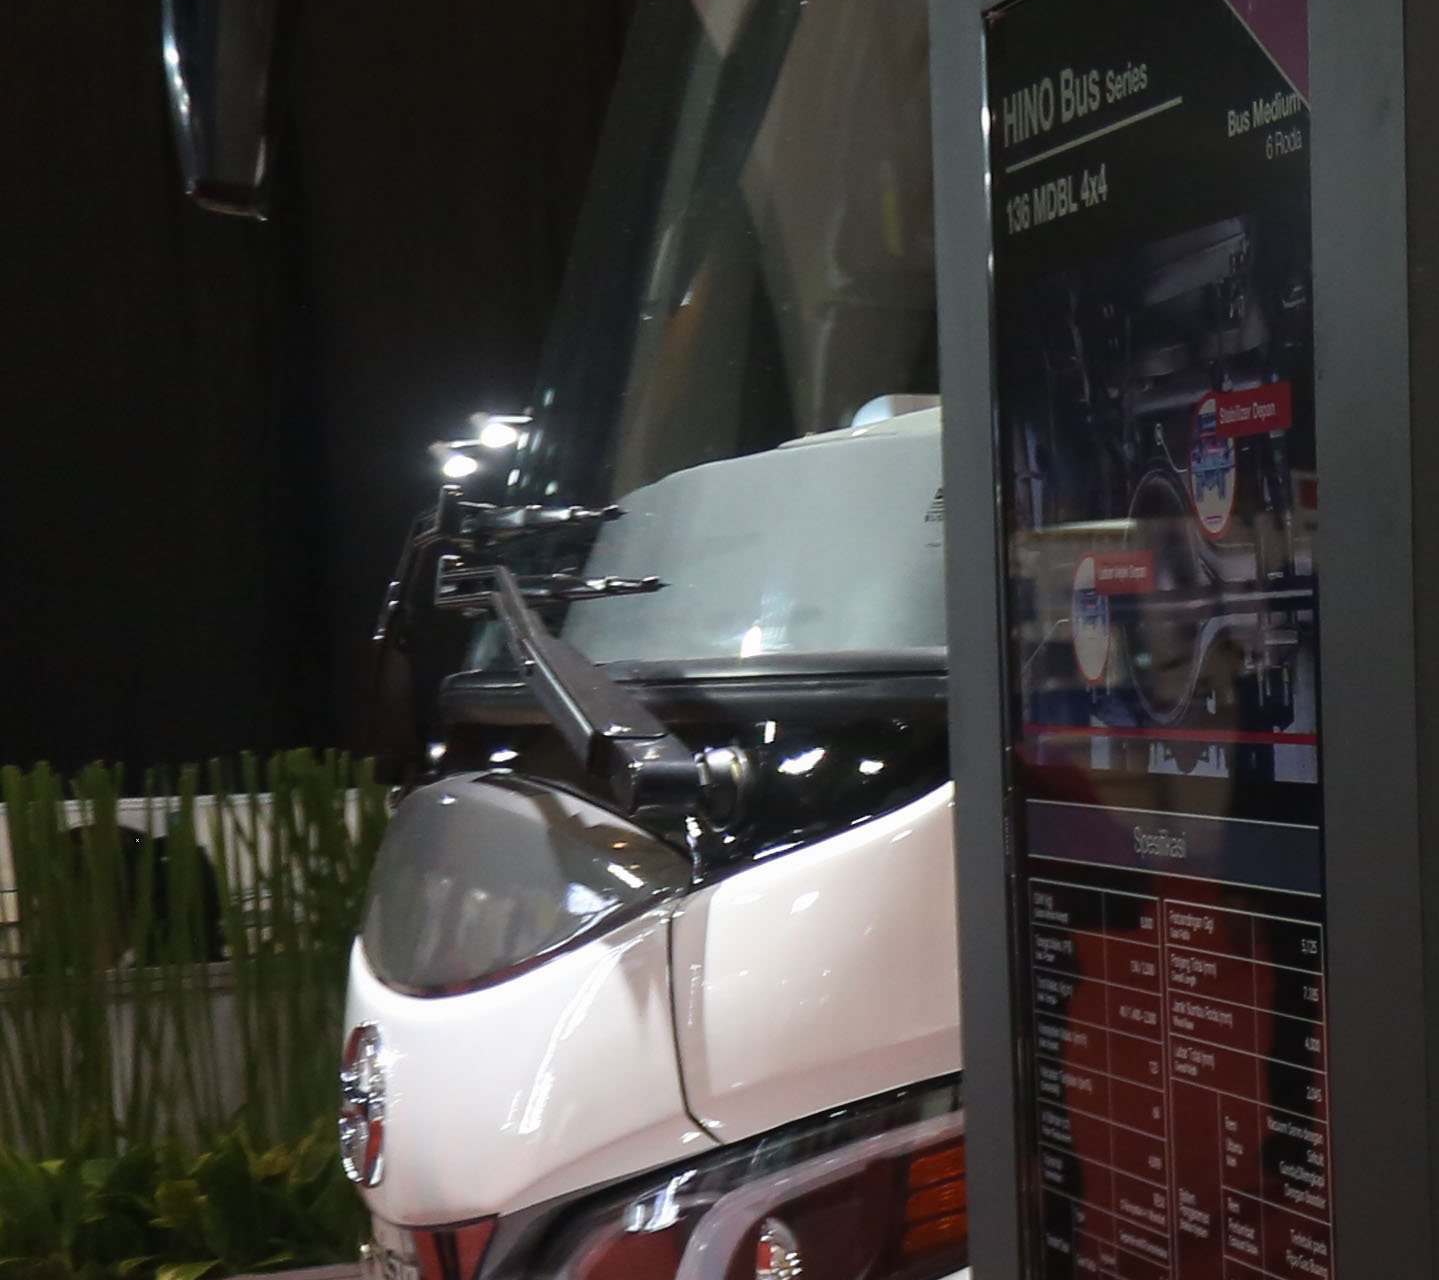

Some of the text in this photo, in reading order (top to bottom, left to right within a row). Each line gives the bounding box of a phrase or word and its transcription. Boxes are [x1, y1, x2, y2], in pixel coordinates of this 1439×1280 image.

[1003, 60, 1149, 148] HINO Bus Series
[1227, 90, 1303, 138] Bus Medium
[1266, 128, 1304, 161] 6 Roda
[1007, 163, 1109, 235] 136 MDBL 4x4
